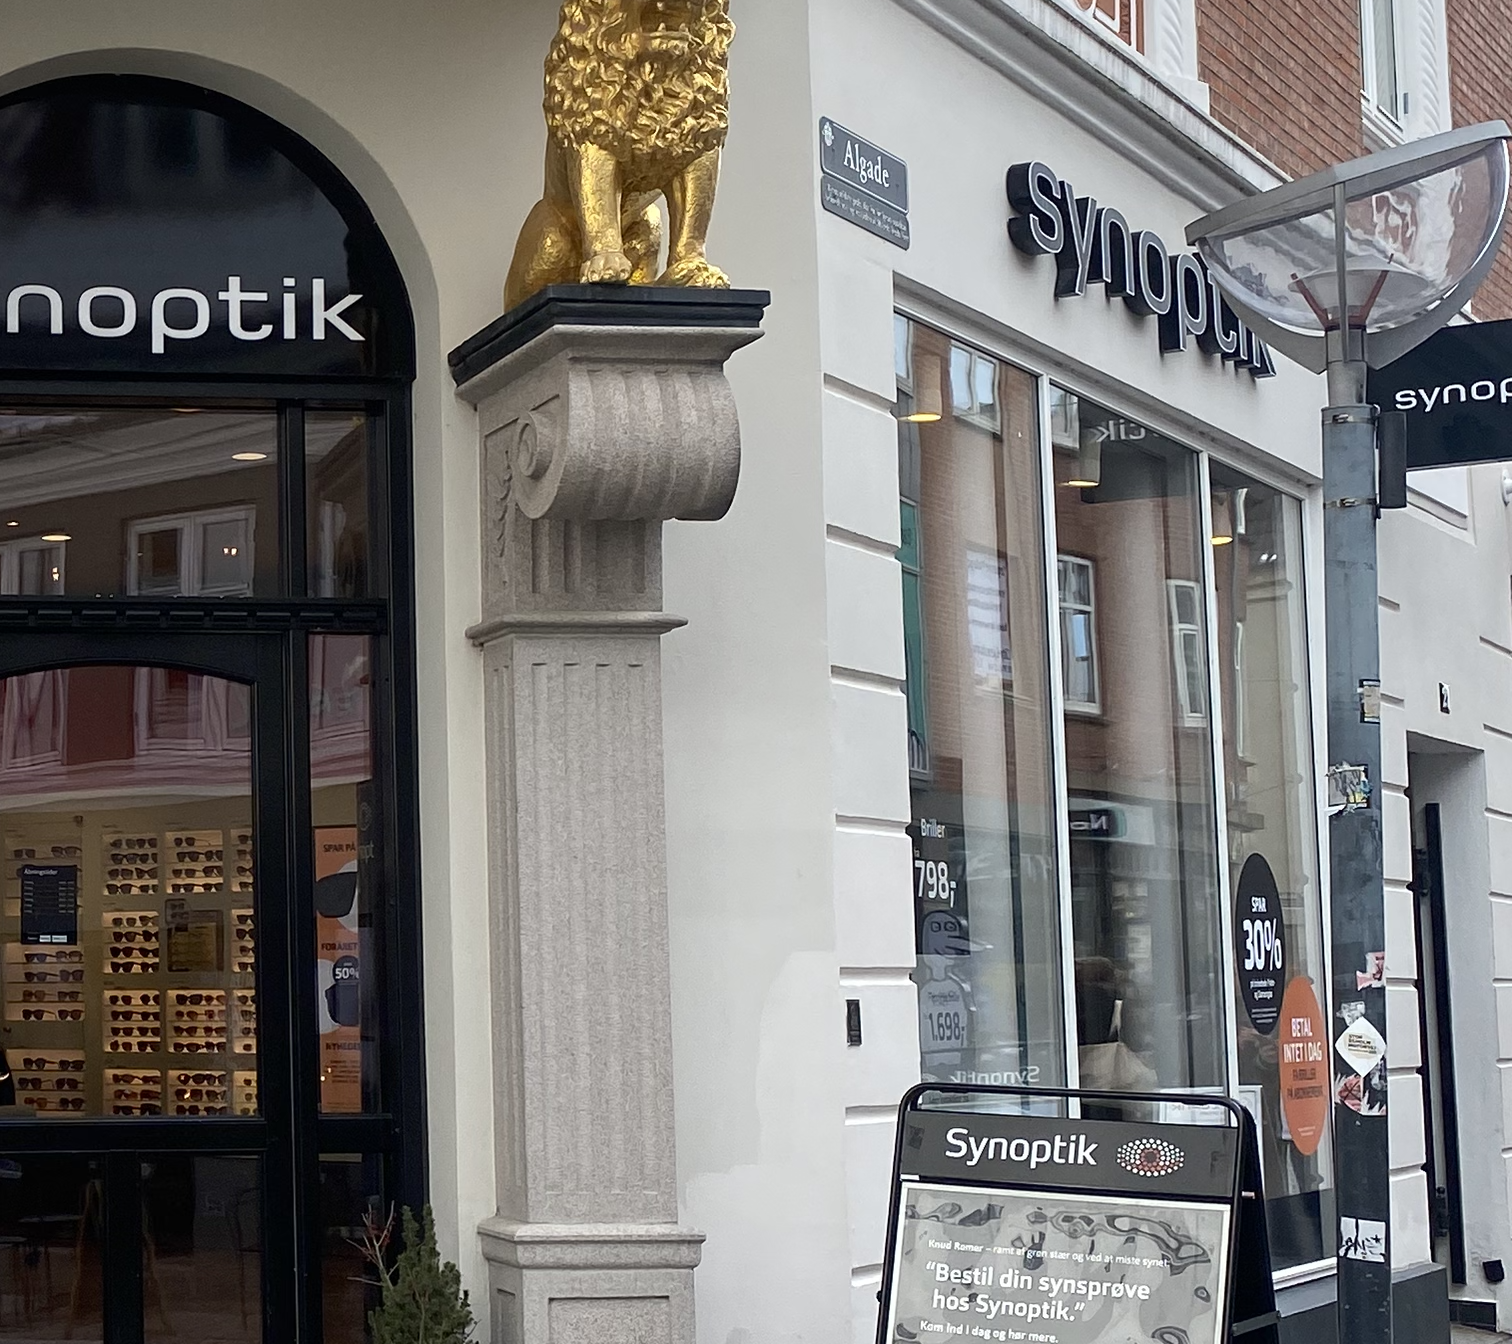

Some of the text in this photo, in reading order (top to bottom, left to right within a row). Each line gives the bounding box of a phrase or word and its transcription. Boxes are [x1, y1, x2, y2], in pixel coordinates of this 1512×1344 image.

[843, 140, 890, 187] Algade
[920, 818, 945, 838] Briller
[323, 843, 345, 853] SPAR
[1251, 896, 1267, 913] SPAR
[1242, 918, 1283, 971] 30%
[1291, 1017, 1313, 1037] BETAL
[1283, 1043, 1304, 1063] INTET
[1308, 1041, 1323, 1062] DAG
[945, 1127, 1099, 1169] Synoptik
[928, 1239, 952, 1250] Knud
[992, 1247, 1012, 1256] ramt
[1013, 1247, 1026, 1256] af
[1071, 1253, 1085, 1263] og
[1085, 1252, 1102, 1262] ved
[1103, 1254, 1114, 1264] at
[1115, 1254, 1141, 1265] miste
[999, 1268, 1033, 1290] din
[1038, 1275, 1151, 1301] synsprøve
[932, 1288, 970, 1312] hos
[920, 1320, 943, 1332] Kom
[946, 1321, 964, 1335] ind
[971, 1325, 993, 1342] dag
[993, 1329, 1006, 1343] og
[1028, 1332, 1059, 1344] mere.
